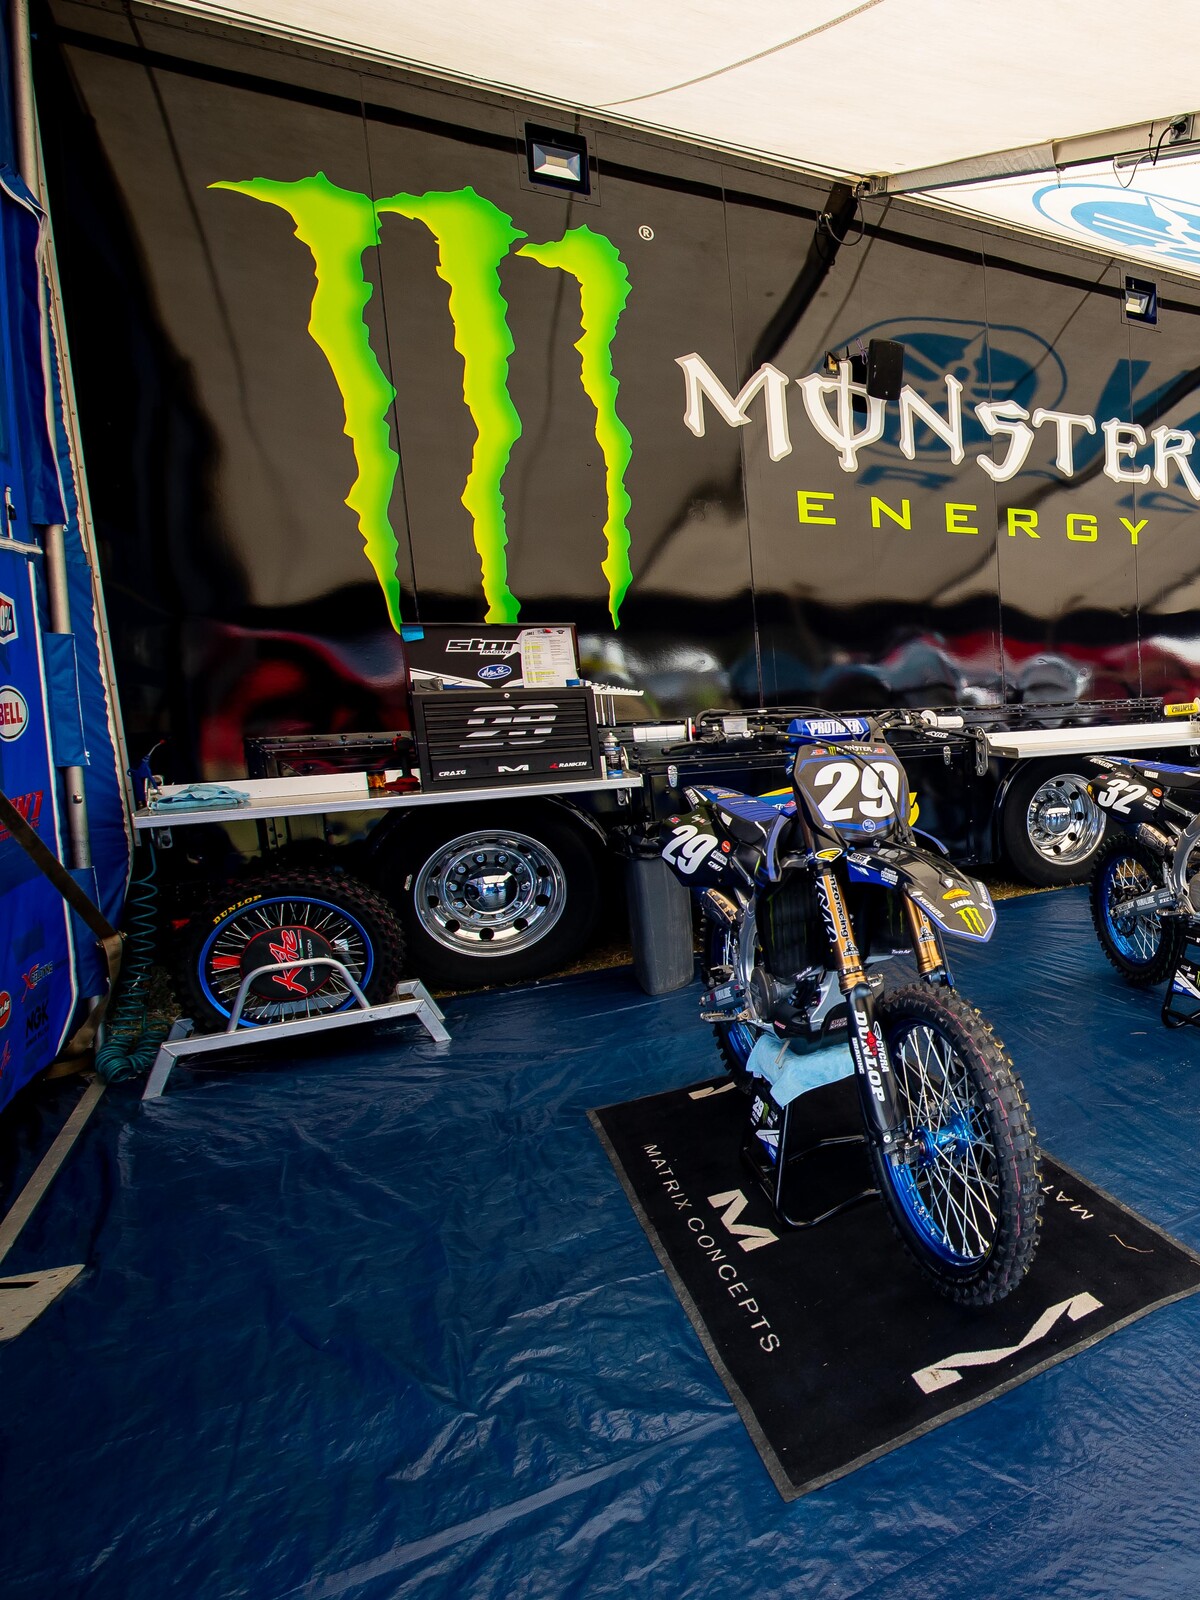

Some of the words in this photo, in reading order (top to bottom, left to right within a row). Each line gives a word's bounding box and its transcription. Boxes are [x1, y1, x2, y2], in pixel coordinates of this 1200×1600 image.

[796, 490, 1149, 545] ENERGY
[0, 605, 12, 631] 0%
[0, 702, 23, 725] BELL
[438, 769, 467, 778] CRAIG
[559, 761, 588, 769] RANKIN
[813, 761, 900, 822] 29
[1097, 778, 1148, 815] 32
[661, 824, 719, 875] 29
[212, 894, 262, 925] DUNLOP
[836, 900, 849, 938] racing
[25, 1001, 49, 1038] NGK
[851, 1037, 865, 1075] BRAKING
[854, 1009, 886, 1102] DUNLOP
[876, 1040, 890, 1073] CYCRA
[1040, 1184, 1094, 1221] MAT
[641, 1143, 692, 1211] MATRIX
[687, 1217, 781, 1353] CONCEPTS
